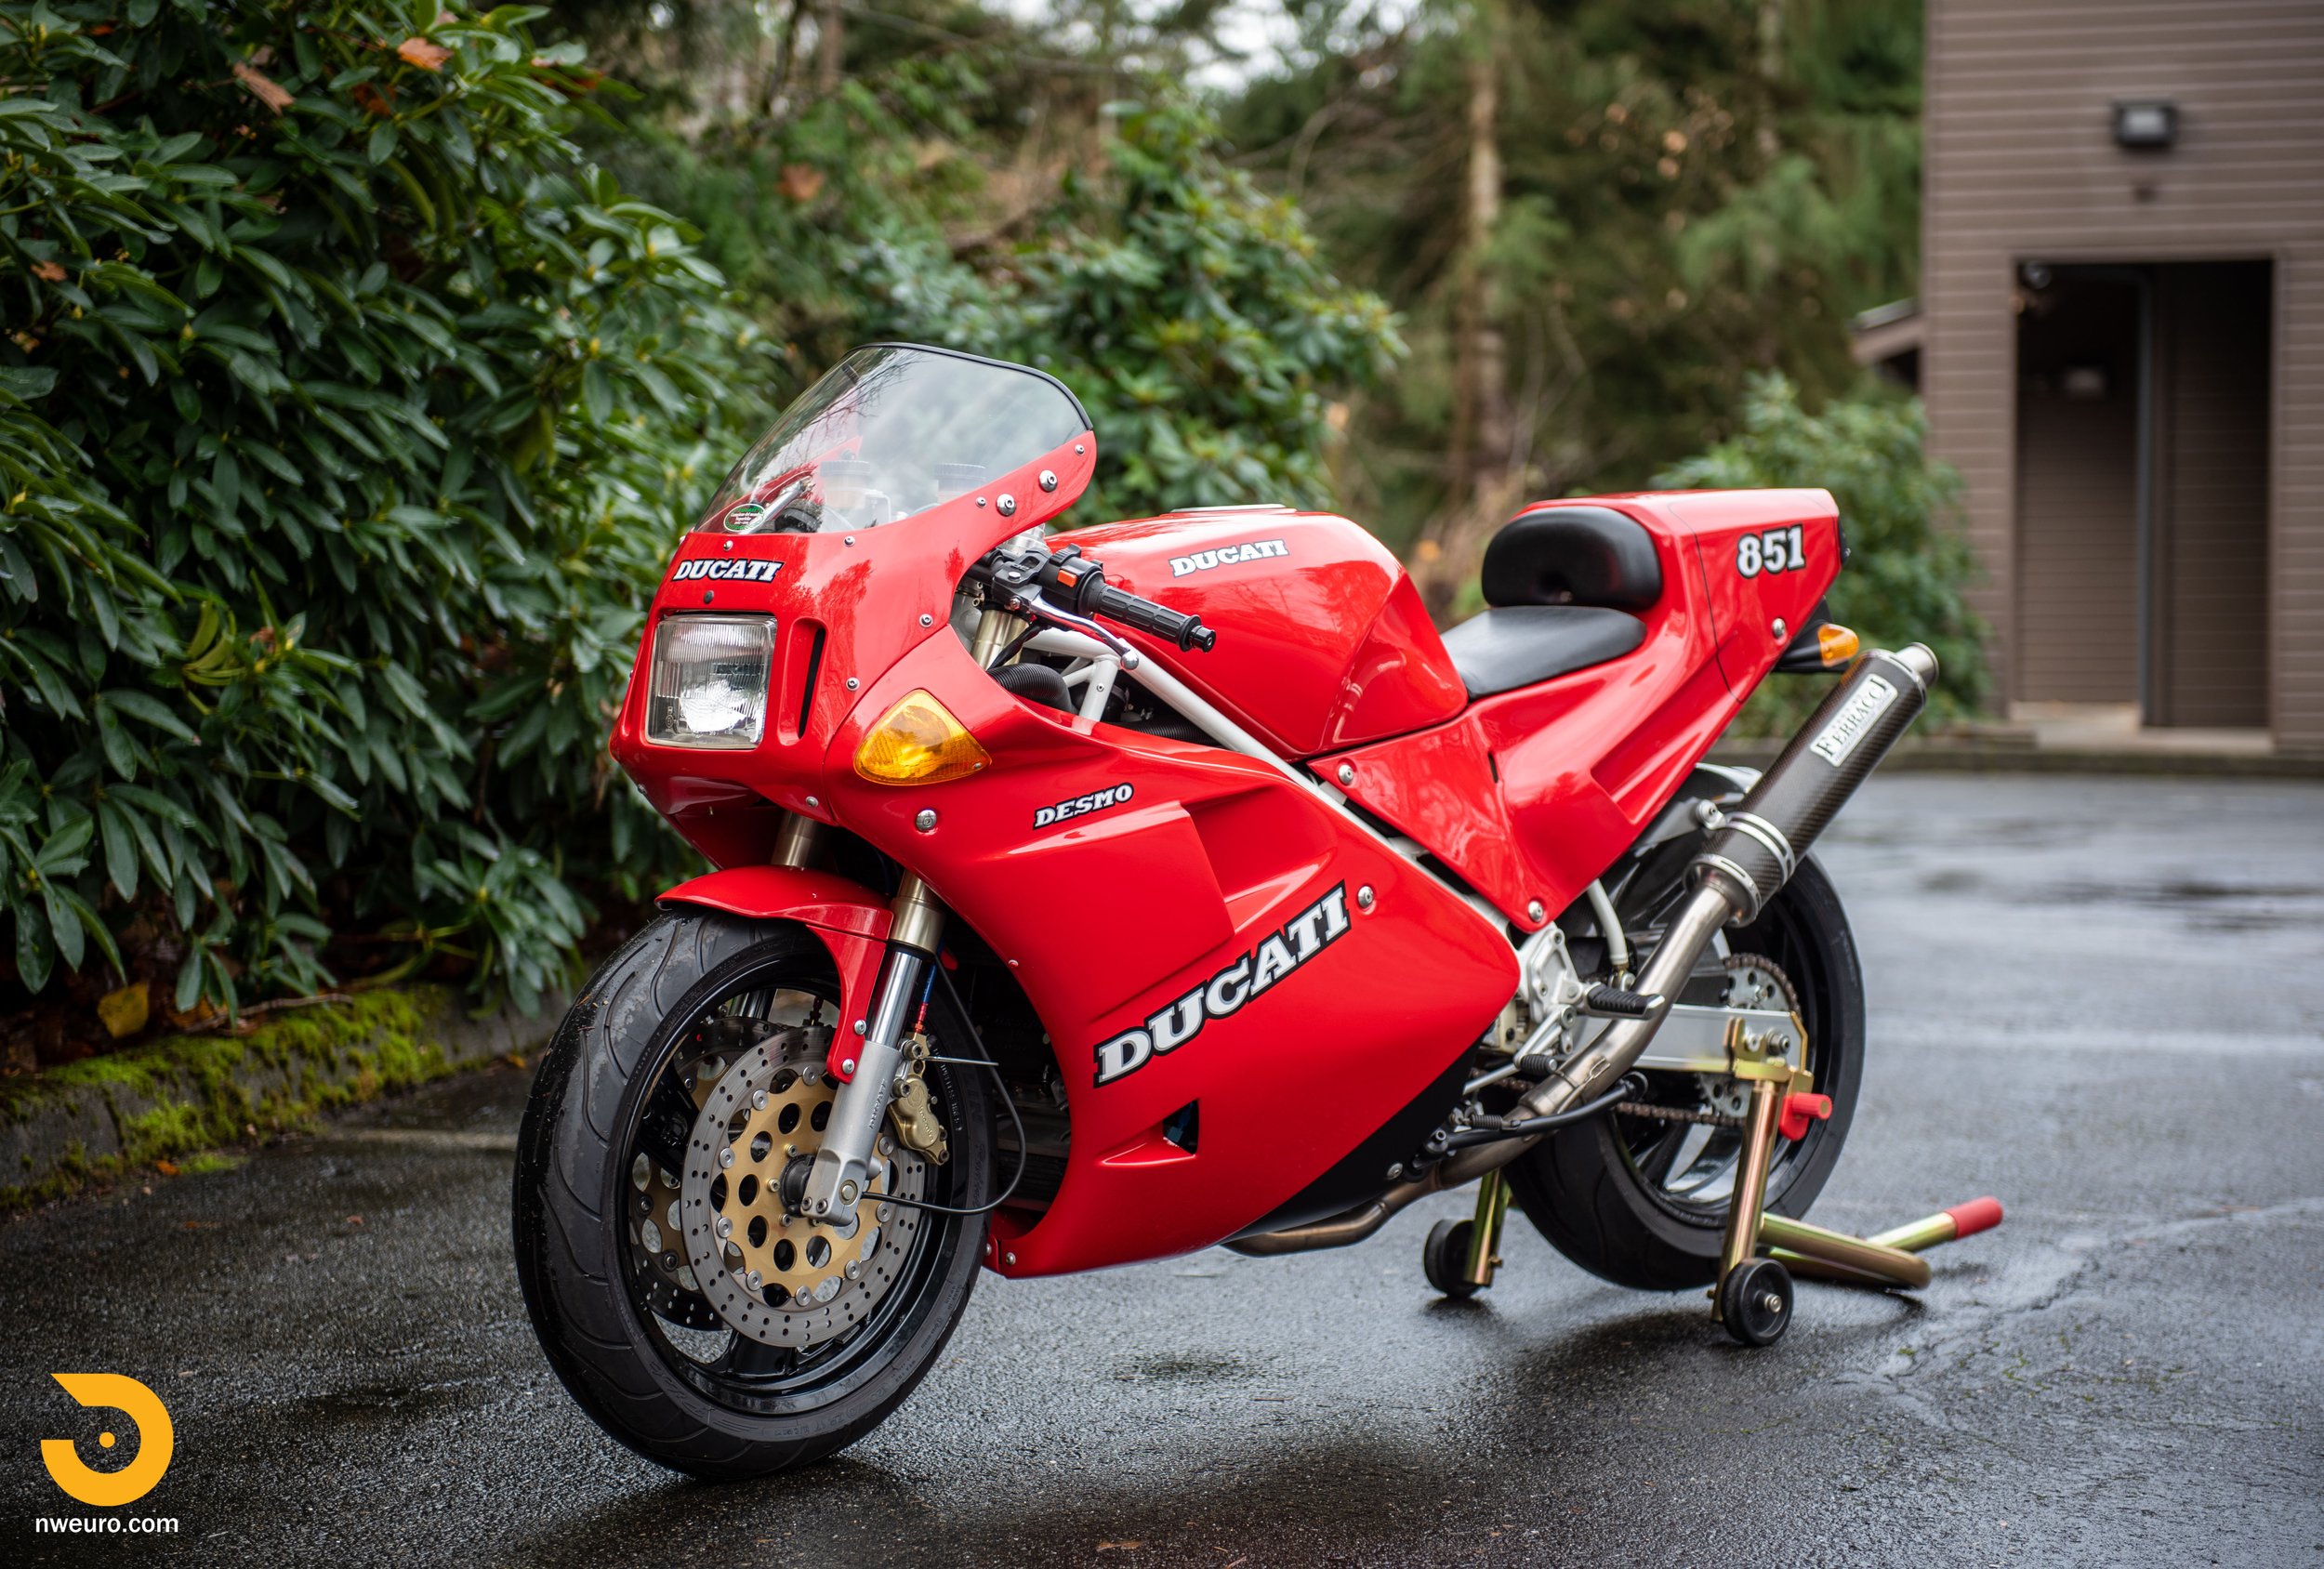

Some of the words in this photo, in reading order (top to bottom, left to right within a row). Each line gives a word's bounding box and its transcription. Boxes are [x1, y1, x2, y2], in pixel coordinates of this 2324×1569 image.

[672, 559, 784, 582] DUCATI
[1169, 539, 1289, 577] DUCATI
[1736, 524, 1805, 578] 851
[1816, 678, 1888, 758] FERRACCI
[1034, 784, 1133, 828] DESMO
[1095, 882, 1350, 1087] DUCATI
